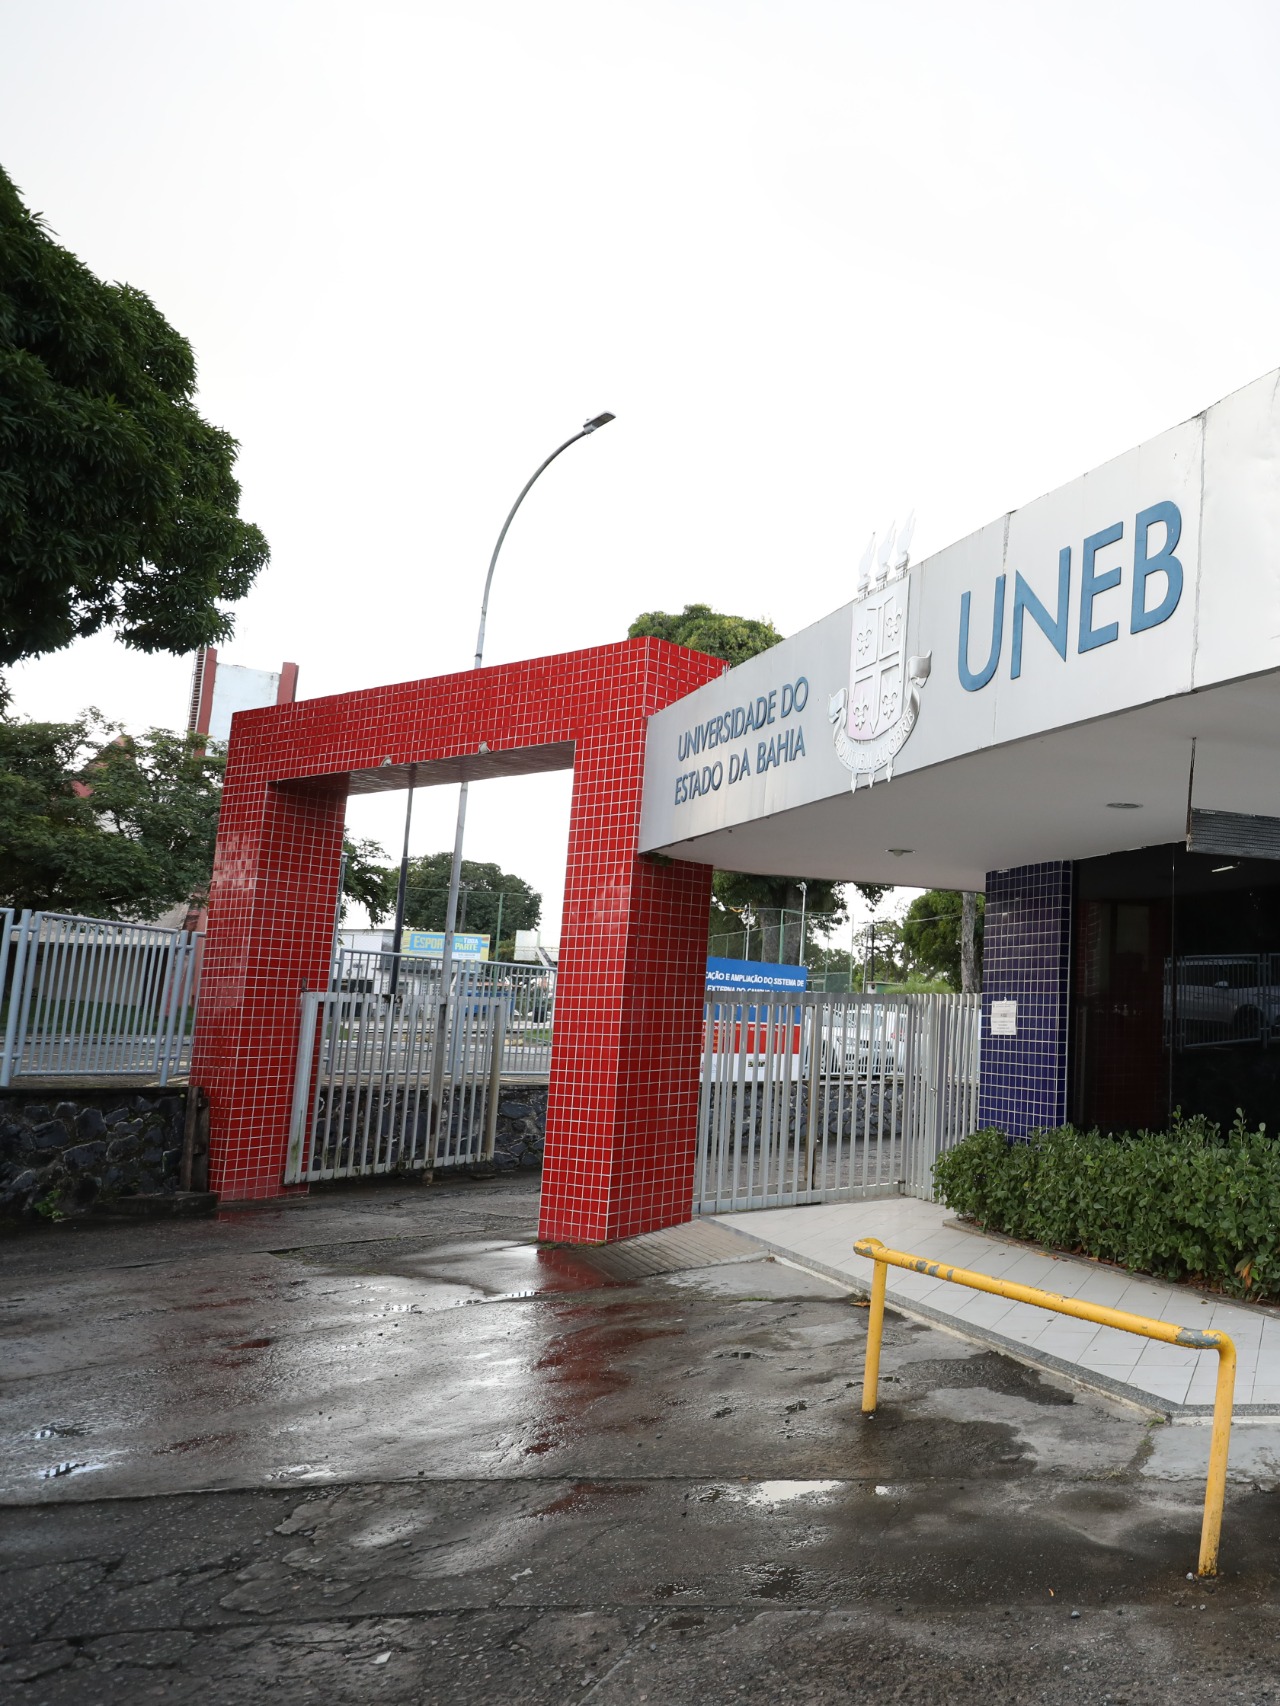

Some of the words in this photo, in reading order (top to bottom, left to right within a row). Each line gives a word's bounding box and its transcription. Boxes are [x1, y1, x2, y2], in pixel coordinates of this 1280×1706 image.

[958, 500, 1184, 692] UNEB
[677, 689, 777, 762] UNIVERSIDADE
[780, 676, 809, 718] DO
[674, 761, 723, 805] ESTADO
[728, 747, 751, 784] DA
[756, 725, 805, 774] BAHIA
[413, 935, 444, 949] ESPOR
[731, 974, 763, 984] AMPLIAÇÃO
[764, 977, 773, 985] DO
[774, 978, 796, 986] SISTEMA
